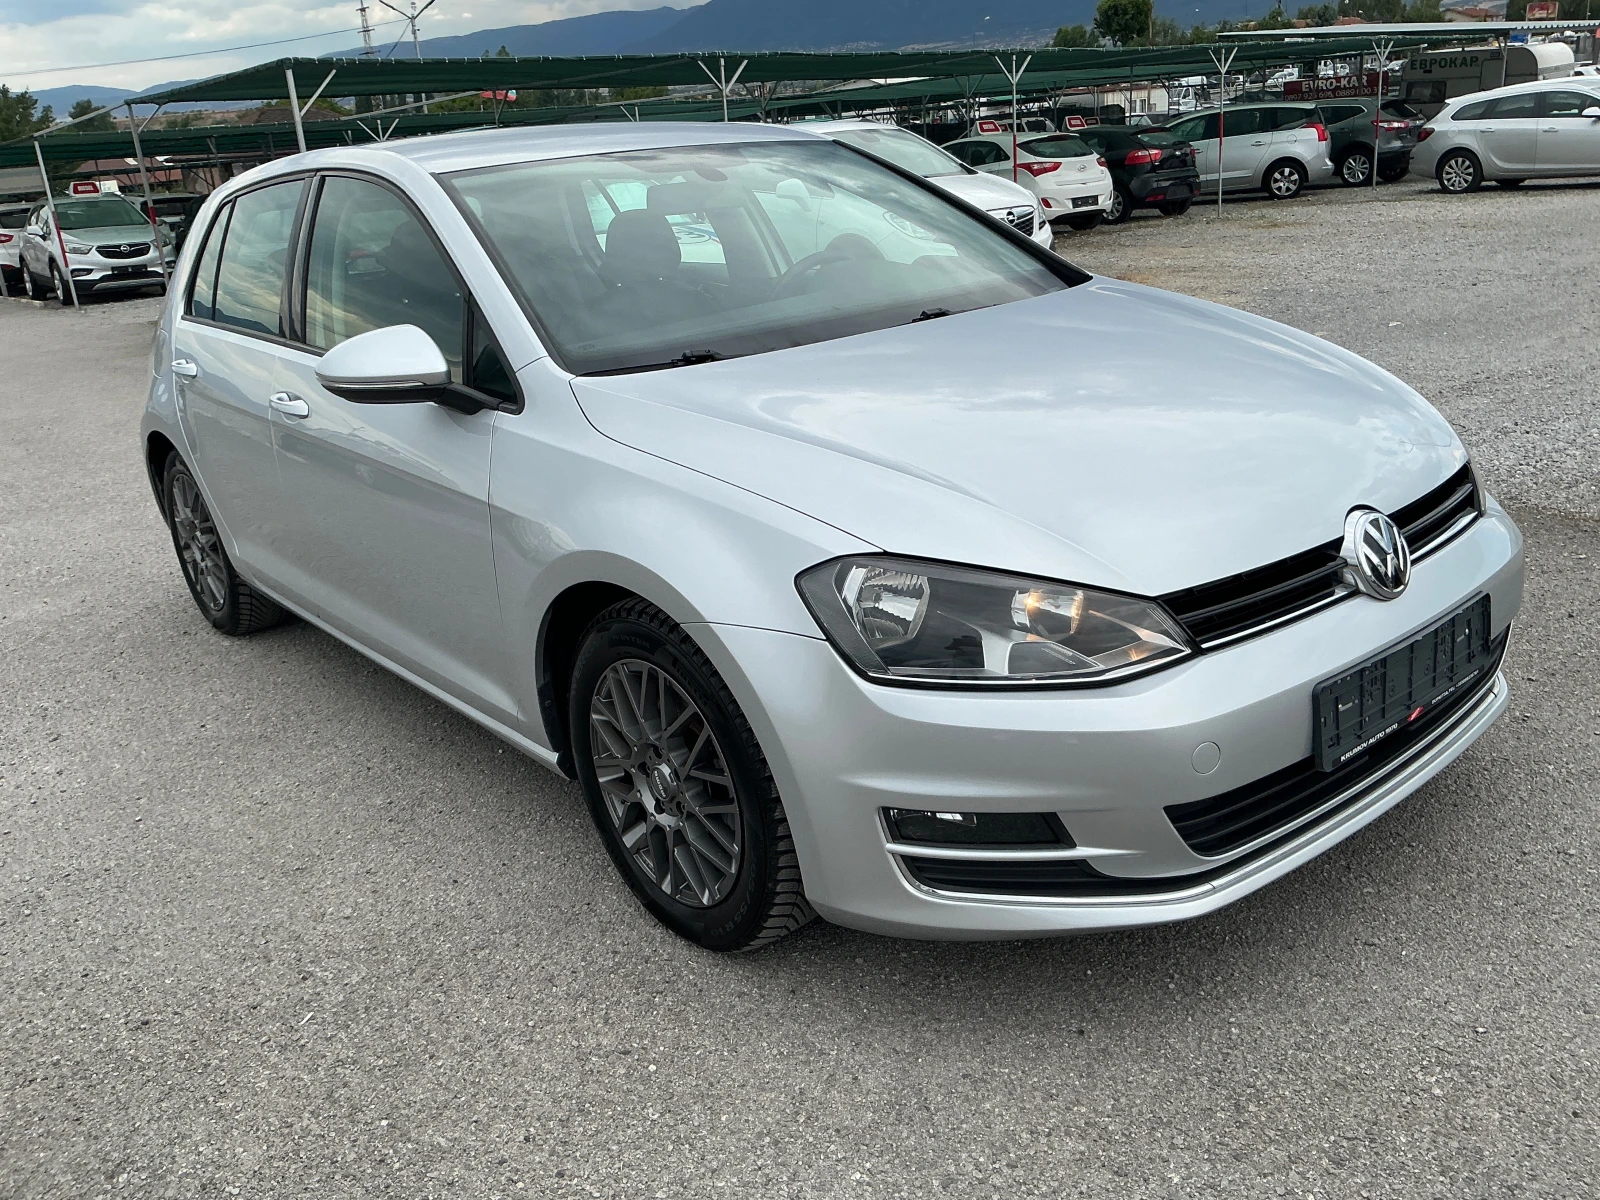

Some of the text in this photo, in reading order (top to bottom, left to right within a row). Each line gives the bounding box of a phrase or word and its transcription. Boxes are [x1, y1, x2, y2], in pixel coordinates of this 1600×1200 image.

[1410, 56, 1478, 70] ЕВРОКАР
[1301, 75, 1368, 92] EVRO-KAR
[1356, 87, 1371, 95] 00
[1373, 85, 1387, 94] 32
[1340, 740, 1368, 762] KRUMOV
[1368, 730, 1385, 745] AUTO
